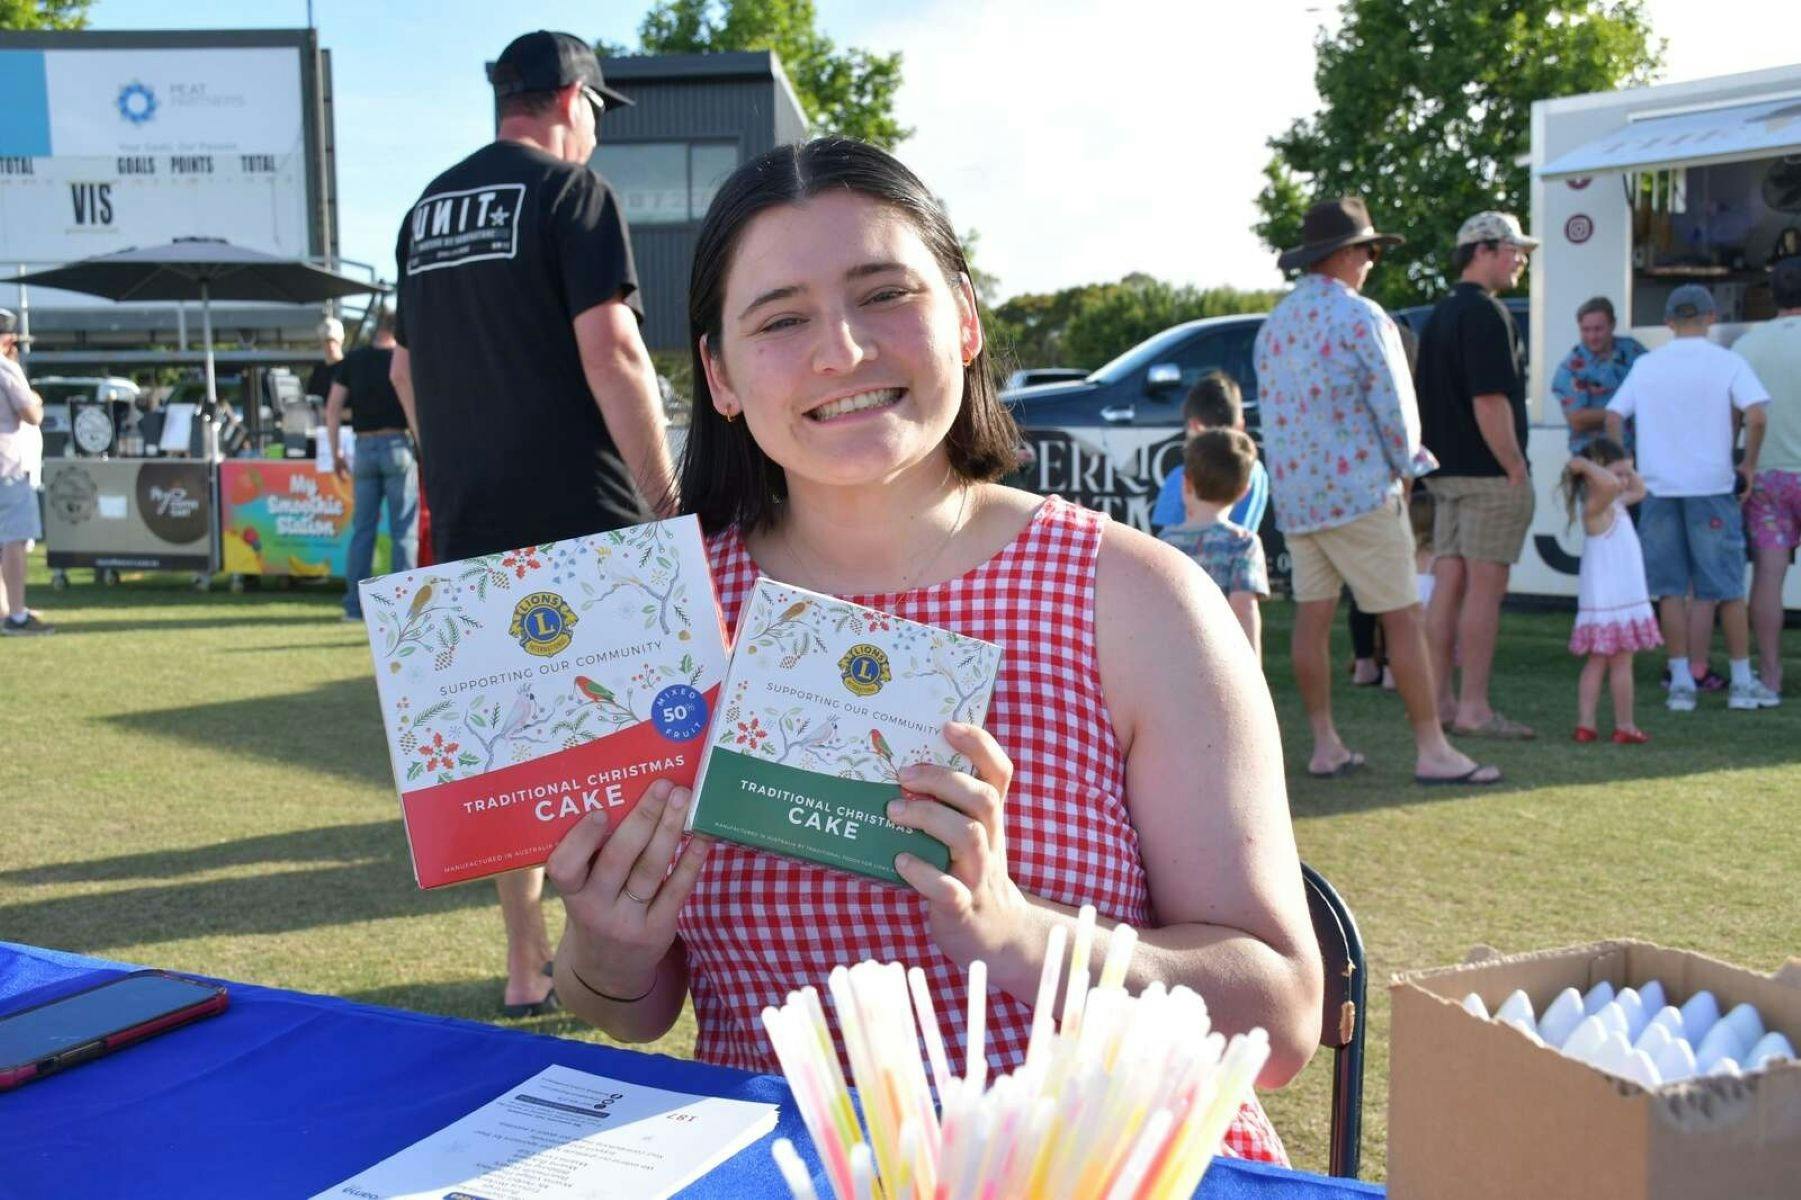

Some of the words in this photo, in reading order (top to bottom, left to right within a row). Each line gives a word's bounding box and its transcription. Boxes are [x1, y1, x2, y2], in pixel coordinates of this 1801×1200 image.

[117, 157, 156, 174] GOALS
[170, 157, 214, 174] POINTS
[241, 155, 277, 173] TOTAL
[70, 182, 115, 225] VIS
[412, 191, 496, 241] UNIT
[519, 594, 560, 613] LIONS
[440, 667, 533, 697] SUPPORTING
[539, 660, 570, 676] OUR
[575, 640, 663, 668] COMMUNITY
[853, 646, 885, 661] LIONS
[657, 687, 696, 706] MIXED
[766, 682, 841, 709] SUPPORTING
[844, 702, 869, 717] OUR
[872, 711, 941, 736] COMMUNITY
[665, 721, 701, 739] FRUIT
[463, 778, 581, 814] TRADITIONAL
[587, 754, 686, 787] CHRISTMAS
[740, 779, 831, 812] TRADITIONAL
[534, 784, 626, 822] CAKE
[788, 807, 859, 841] CAKE
